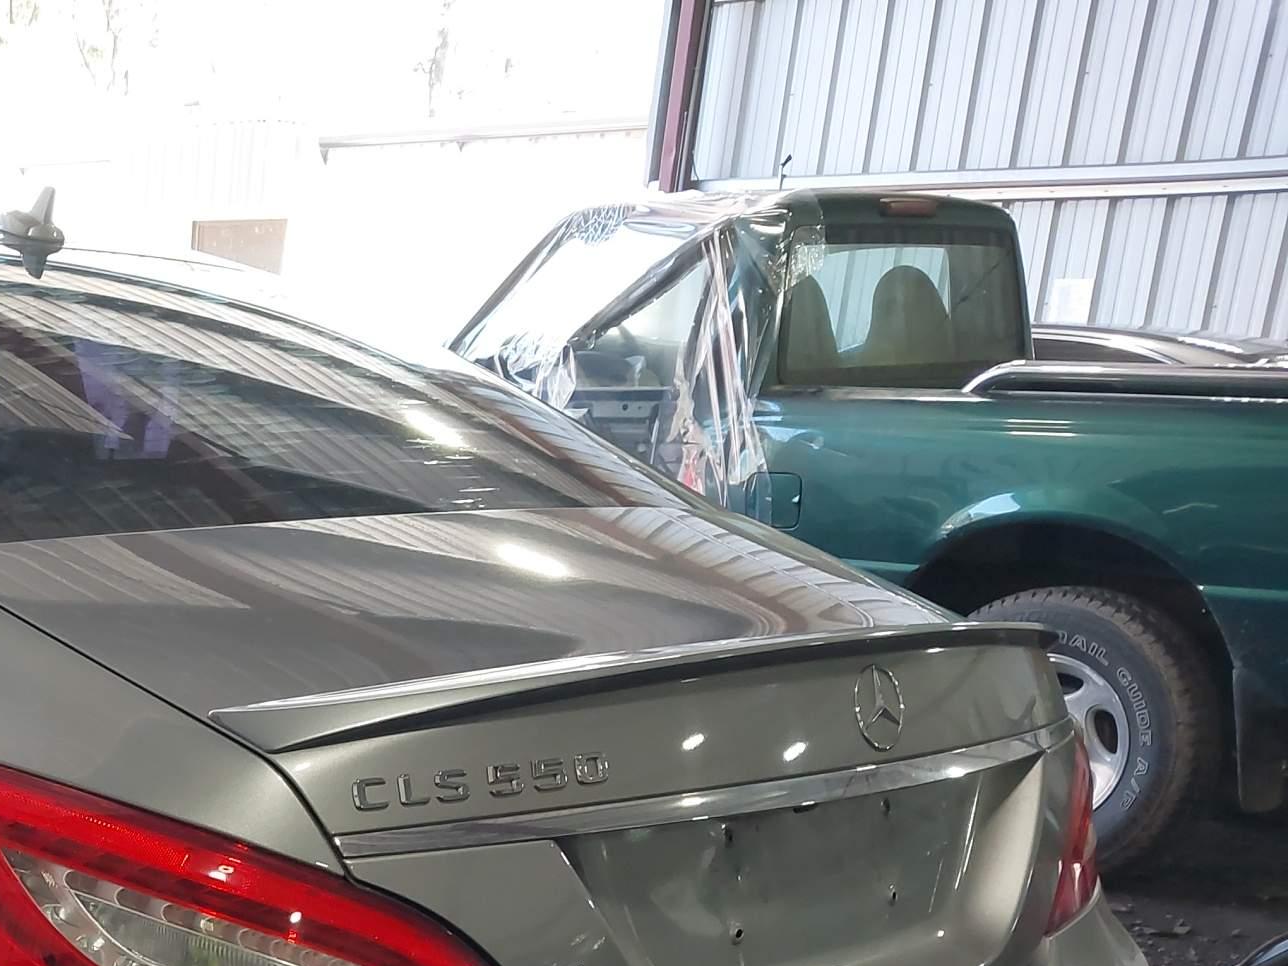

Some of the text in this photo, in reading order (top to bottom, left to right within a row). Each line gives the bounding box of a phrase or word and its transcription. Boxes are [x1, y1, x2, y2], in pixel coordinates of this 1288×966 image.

[1116, 667, 1152, 746] GUIDE
[352, 752, 609, 811] CLS 550
